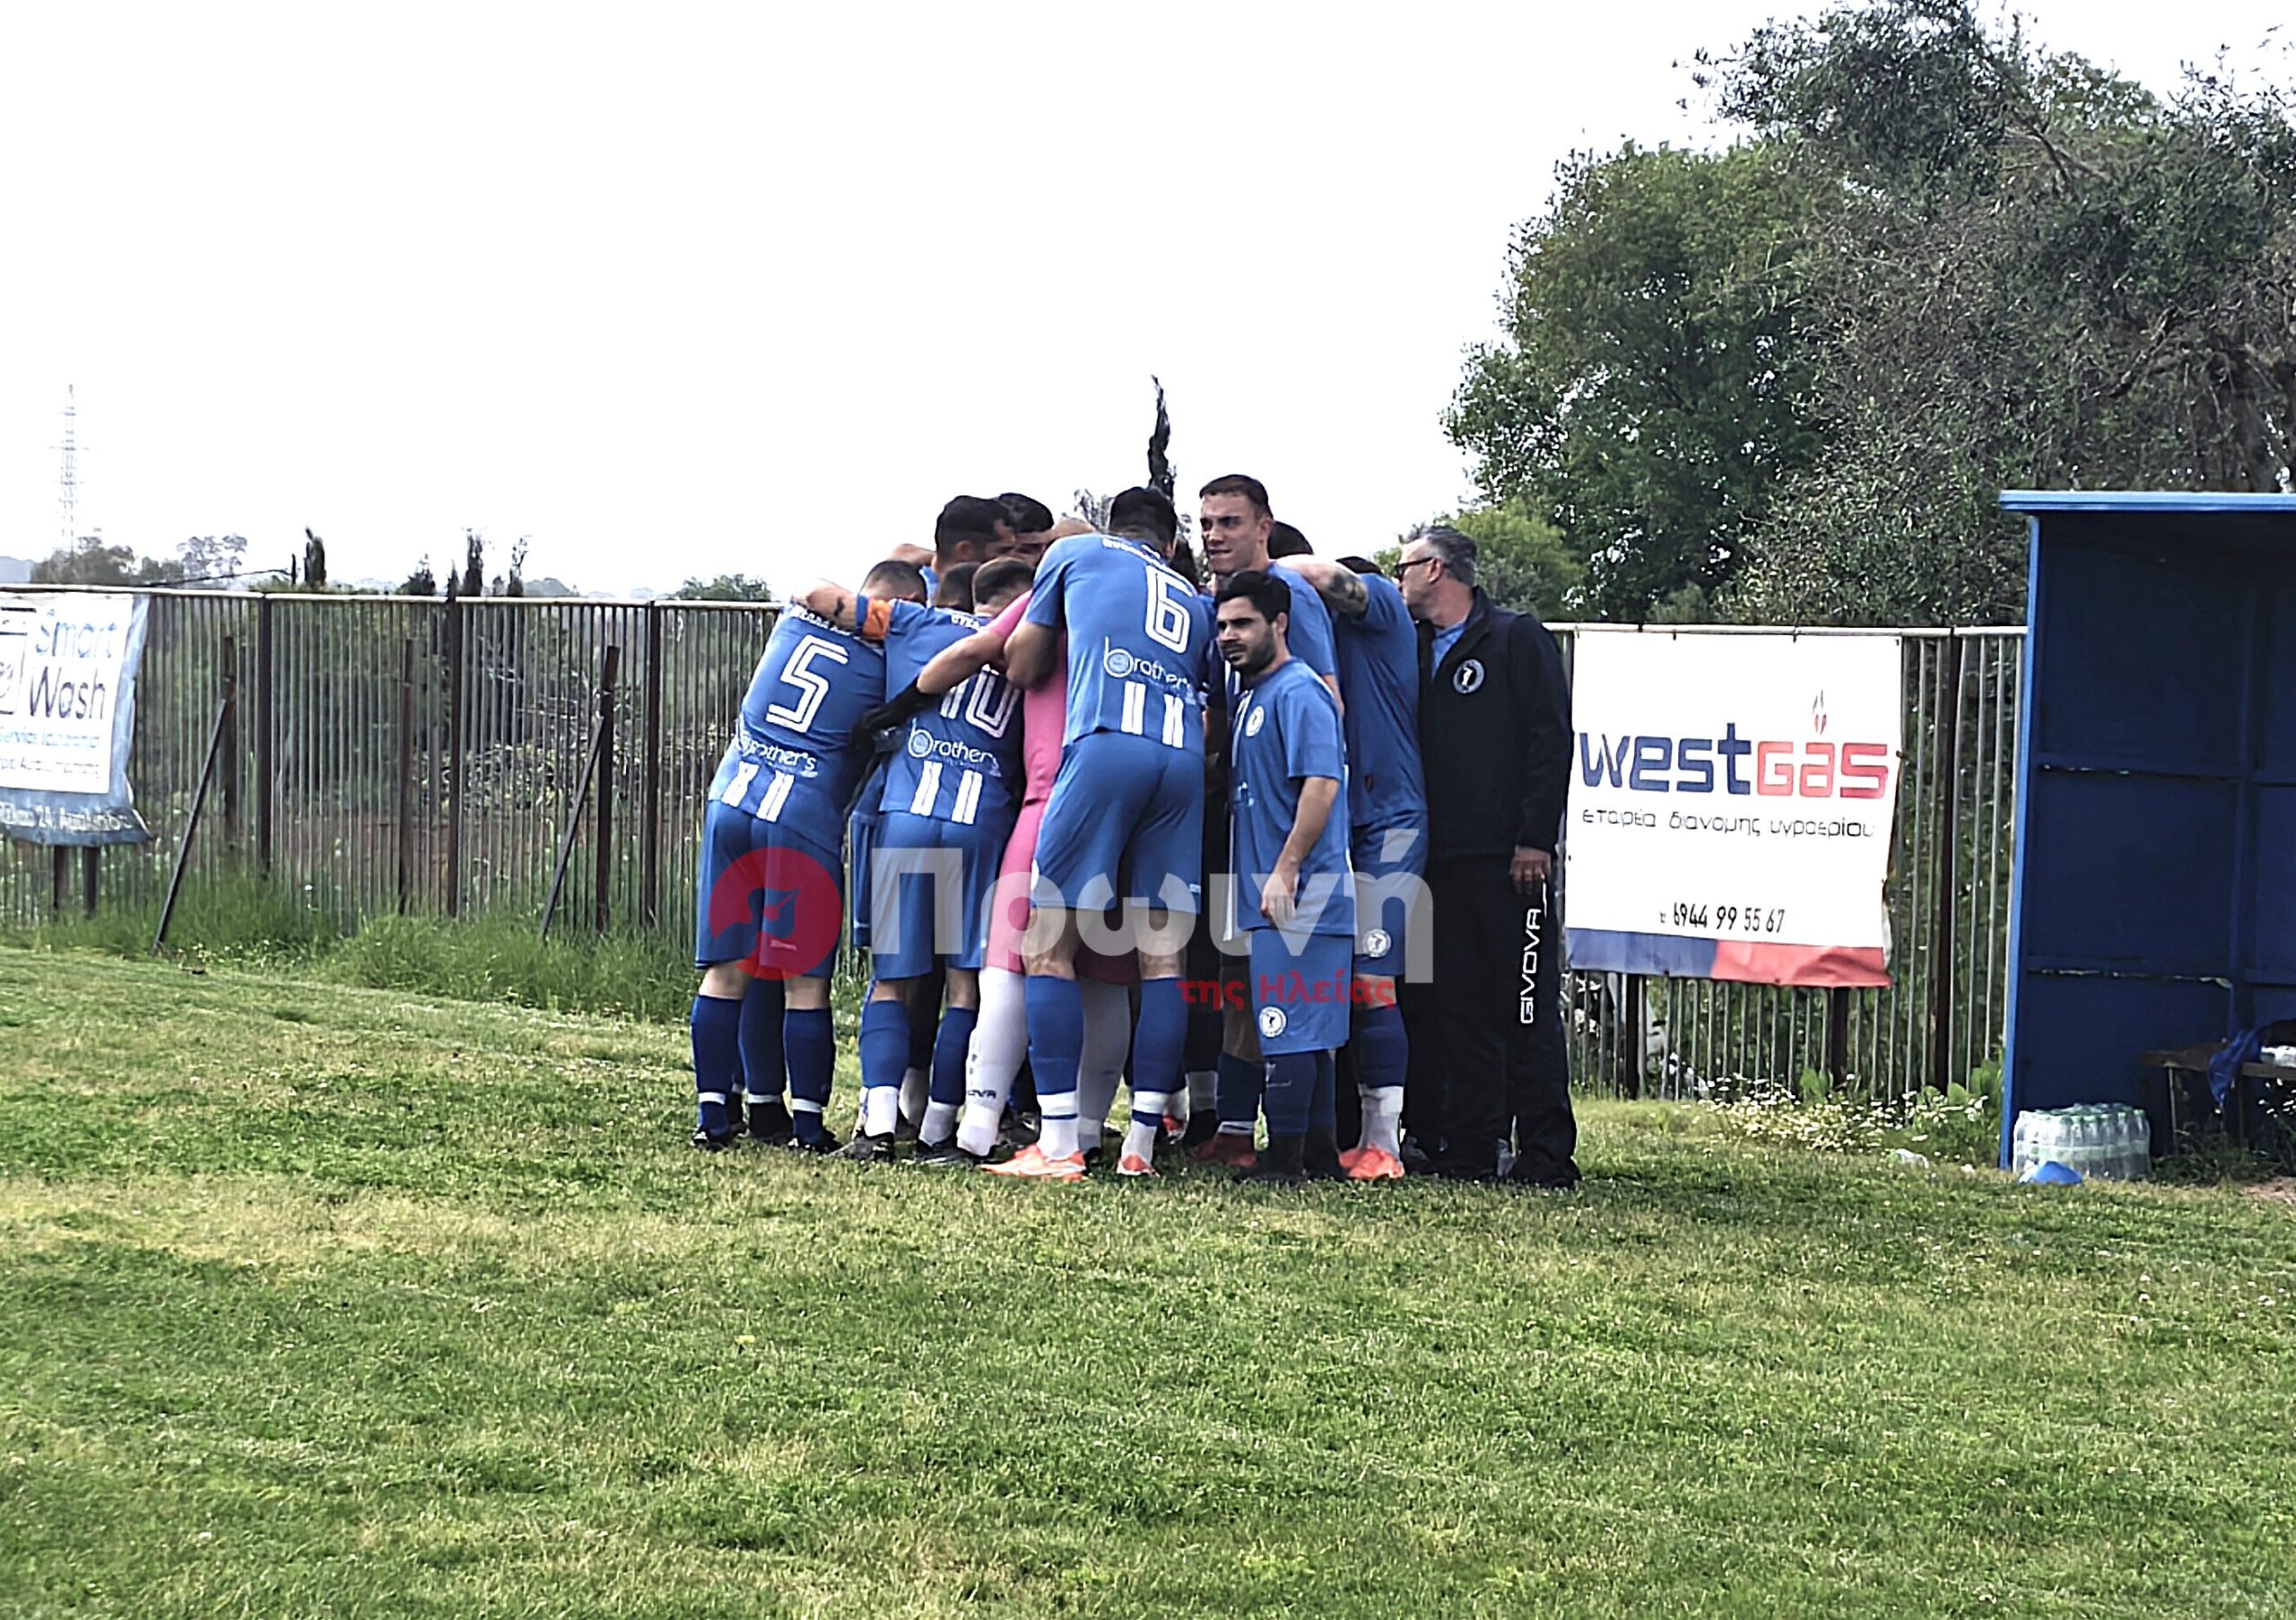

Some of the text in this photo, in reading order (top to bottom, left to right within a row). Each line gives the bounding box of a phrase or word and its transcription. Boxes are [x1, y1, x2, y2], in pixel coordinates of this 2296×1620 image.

[1144, 564, 1194, 654] 6
[29, 665, 107, 720] Wash
[765, 634, 849, 734] 5
[1673, 901, 1708, 928] 6944
[1716, 905, 1737, 930] 99
[1744, 907, 1761, 932] 55
[1765, 908, 1785, 933] 67
[1519, 908, 1543, 1024] GIVOVA
